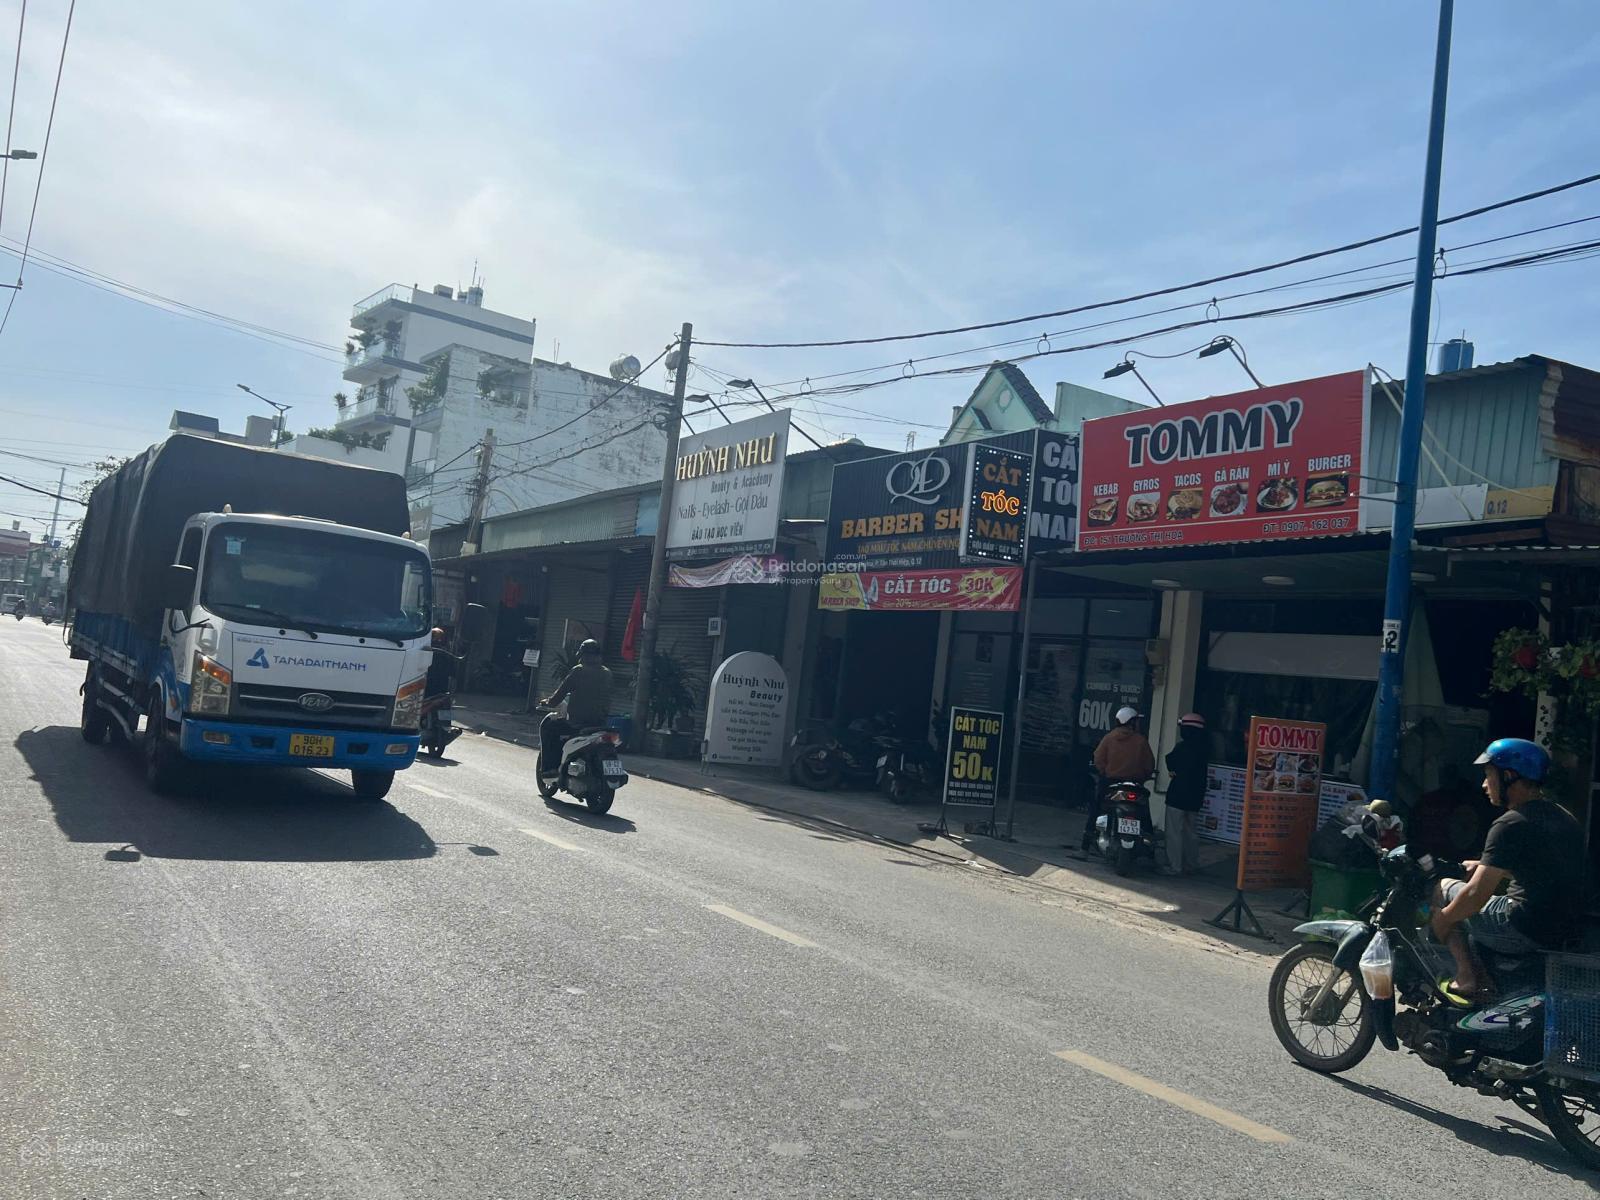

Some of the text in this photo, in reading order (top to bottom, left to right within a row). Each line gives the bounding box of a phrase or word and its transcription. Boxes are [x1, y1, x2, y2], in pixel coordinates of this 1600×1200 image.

[1124, 398, 1303, 468] TOMMY
[676, 431, 776, 481] HUỲNH NHƯ
[1043, 433, 1077, 471] CẮ
[983, 456, 1022, 487] CẮT
[1229, 464, 1250, 482] RÁN
[1308, 454, 1352, 473] BURGER
[1093, 482, 1119, 497] KEBAB
[1133, 477, 1160, 492] GYROS
[1174, 472, 1202, 487] TACOS
[702, 499, 730, 519] Eyelash
[980, 489, 1020, 516] TÓC
[841, 508, 964, 540] BARBER SH
[976, 518, 1019, 543] NAM
[884, 574, 995, 595] CẮT TÓC 30K
[273, 655, 366, 672] TANADAITHANH
[763, 678, 785, 690] Như
[750, 690, 783, 703] Beauty
[1078, 698, 1113, 731] 60K
[962, 735, 988, 750] NAM
[1257, 724, 1322, 751] TOMMY
